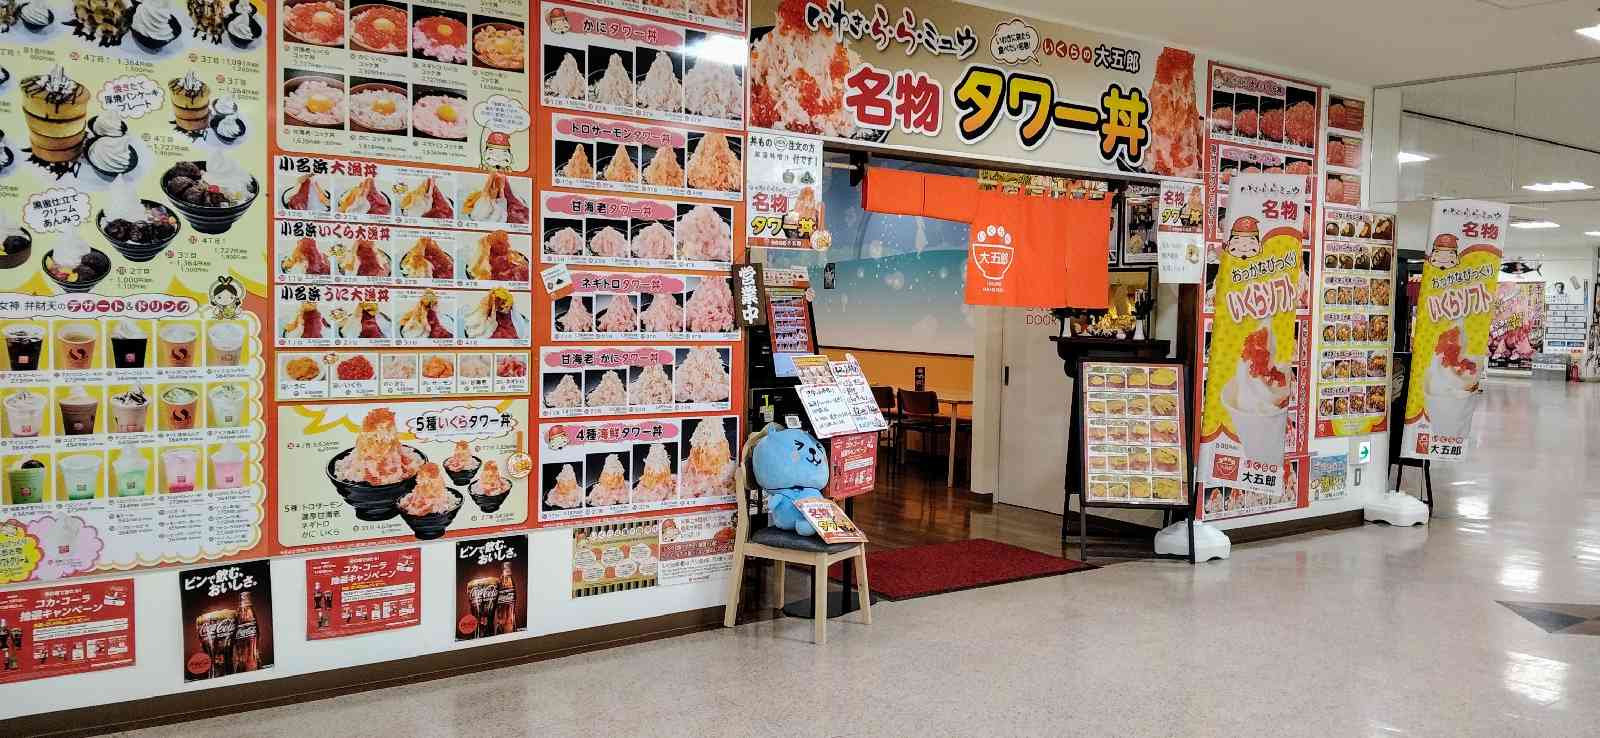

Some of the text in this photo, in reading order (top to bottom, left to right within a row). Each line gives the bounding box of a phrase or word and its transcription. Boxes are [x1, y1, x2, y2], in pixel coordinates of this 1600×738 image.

[583, 18, 659, 43] かにタワー丼
[1043, 38, 1141, 74] いくらの 大五郎
[845, 63, 1152, 168] 名物 タワー丼
[570, 123, 673, 145] トロサーモンタワー丼
[279, 156, 379, 178] 小名浜大漁丼
[571, 199, 653, 218] 甘海老タワー丼
[753, 192, 788, 213] 名物
[1163, 191, 1185, 207] 名物
[42, 205, 77, 217] クリーム
[1262, 199, 1299, 221] 名物
[43, 214, 81, 228] あんみつ
[280, 221, 391, 241] 小名浜いくら大漁丼
[1461, 221, 1499, 239] 名物
[978, 250, 1009, 265] 大五郎
[1232, 249, 1297, 283] おっかなびっくり
[582, 277, 664, 292] ネギトロタワー丼
[1431, 263, 1494, 289] おっかなびっくり
[280, 285, 391, 302] 小名浜うに大漁丼
[738, 264, 760, 326] 営業中
[1226, 272, 1297, 324] いくらソフト
[1427, 282, 1493, 324] いくらソフト
[415, 413, 511, 433] 5種いくらタワー丼
[575, 424, 664, 442] 4種海鮮タワー丼
[1430, 444, 1462, 456] 大五郎
[1242, 471, 1277, 487] 大五郎
[460, 539, 507, 559] ビンで飲む、
[477, 548, 518, 565] おいしさ。
[184, 567, 244, 591] ビンで飲む、
[207, 575, 259, 597] おいしさ。
